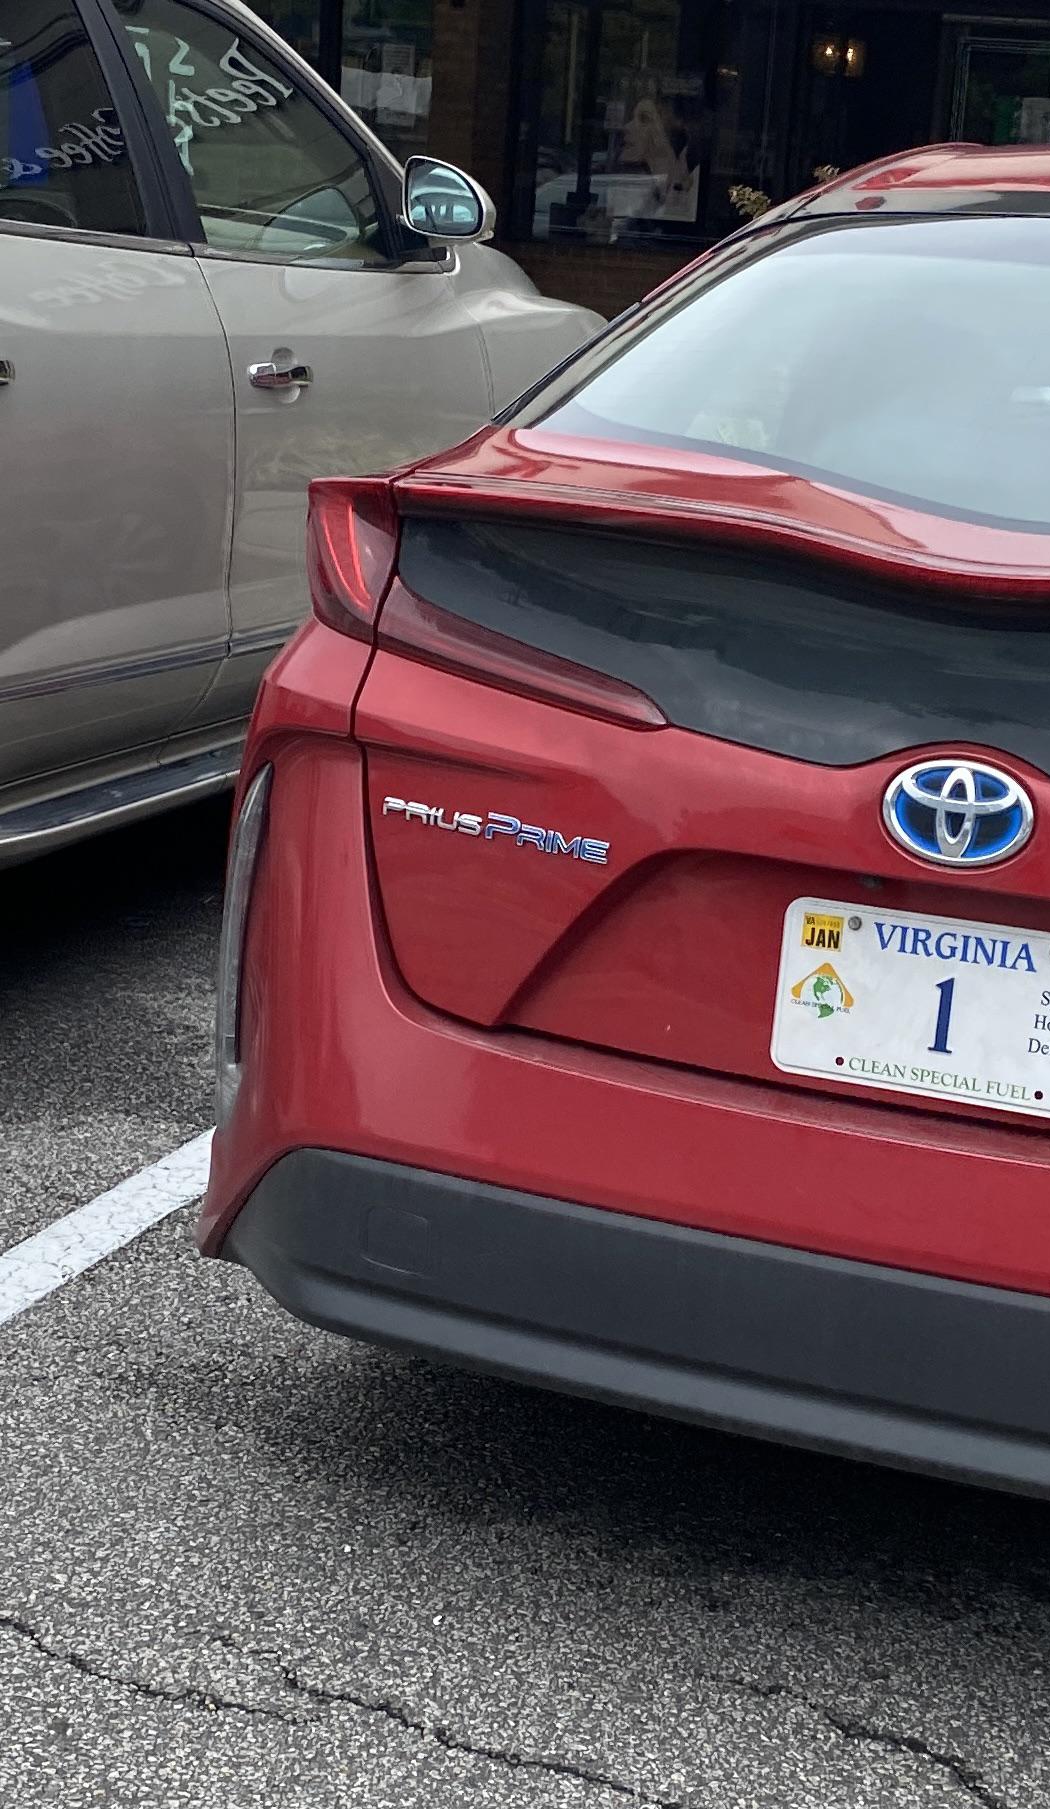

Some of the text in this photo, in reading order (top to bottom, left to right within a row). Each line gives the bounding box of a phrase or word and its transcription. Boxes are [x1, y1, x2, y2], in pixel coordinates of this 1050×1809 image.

[383, 796, 611, 865] PRIUS PRIME
[805, 927, 840, 949] JAN
[874, 922, 1037, 973] VIRGINIA
[928, 977, 955, 1053] 1
[848, 1056, 1032, 1101] CLEAN SPECIAL FUEL
